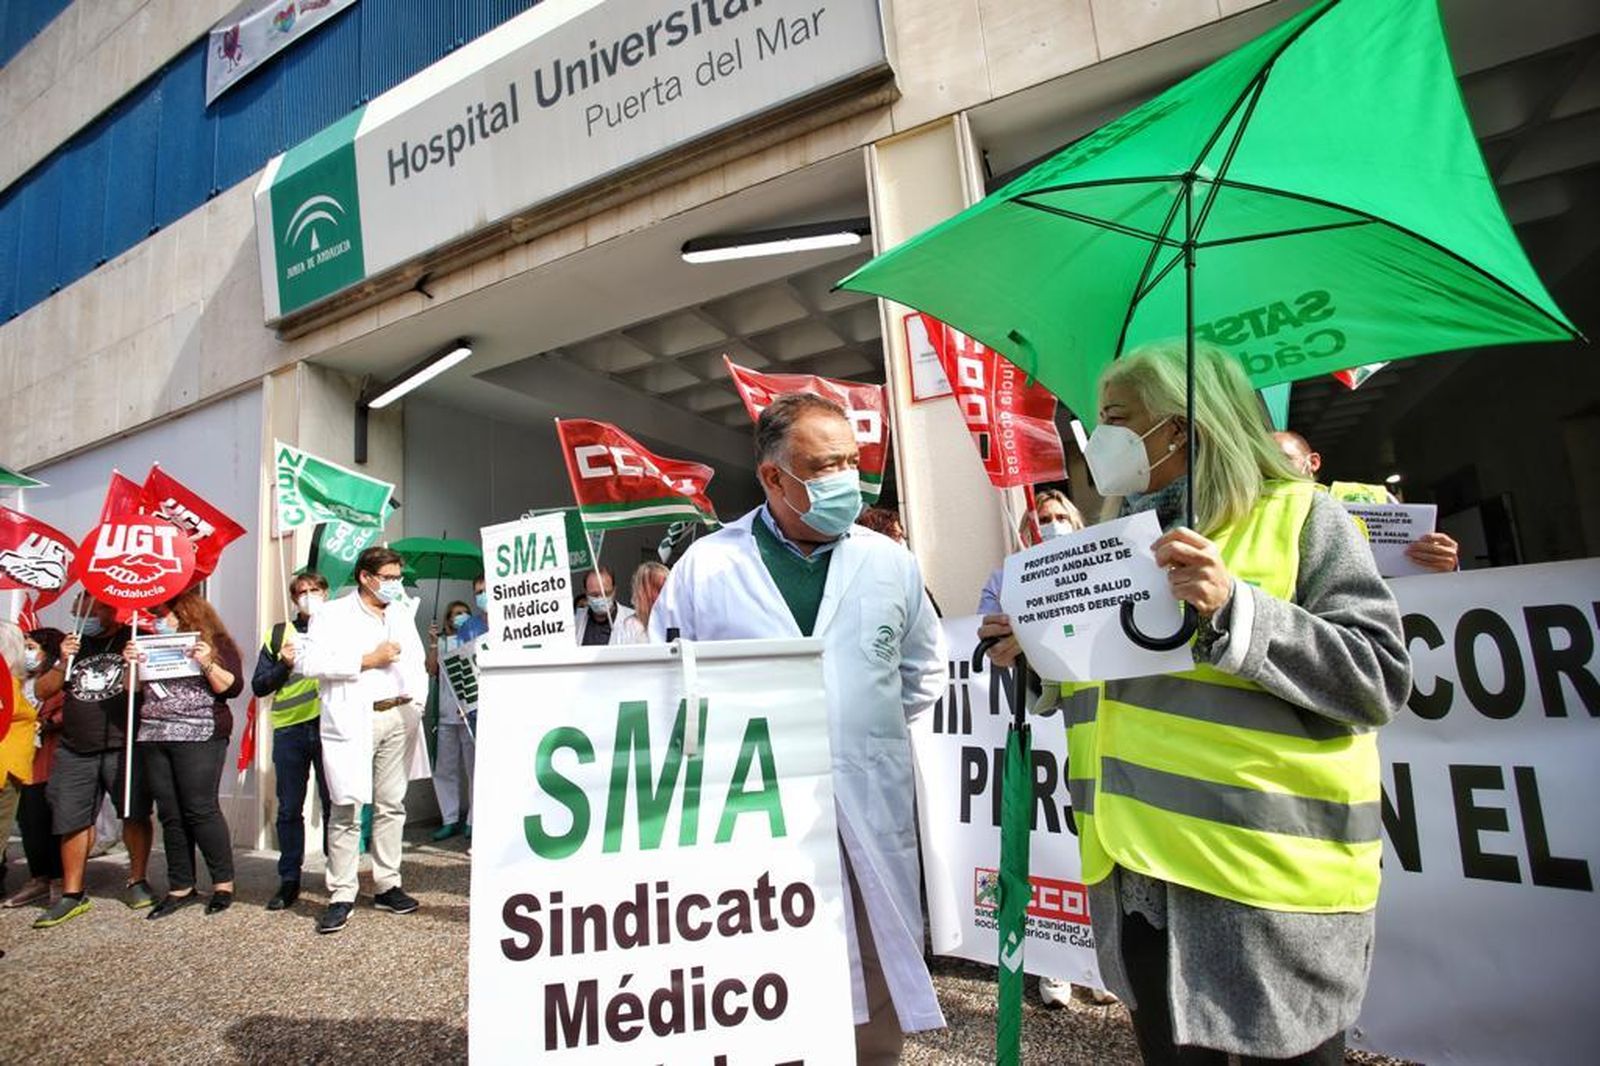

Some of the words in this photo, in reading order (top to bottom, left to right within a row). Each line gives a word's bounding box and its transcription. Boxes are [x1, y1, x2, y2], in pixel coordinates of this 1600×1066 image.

[585, 75, 682, 138] Puerta
[695, 38, 744, 88] del
[754, 8, 827, 61] Mar
[387, 83, 520, 186] Hospital
[306, 256, 316, 270] DE
[95, 524, 179, 560] UGT
[495, 533, 558, 577] SMA
[1024, 541, 1098, 571] PROFESIONALES
[1099, 537, 1123, 551] DEL
[1020, 565, 1060, 584] SERVICIO
[1062, 554, 1111, 574] ANDALUZ
[1115, 548, 1132, 560] DE
[1054, 572, 1088, 587] SALUD
[493, 577, 566, 601] Sindicato
[1026, 596, 1044, 608] POR
[1045, 586, 1091, 605] NUESTRA
[1093, 578, 1132, 593] SALUD
[503, 599, 560, 620] Médico
[1018, 613, 1035, 624] POR
[1037, 604, 1085, 621] NUESTROS
[1088, 590, 1150, 611] DERECHOS
[502, 620, 565, 642] Andaluz
[1401, 601, 1600, 720] COR
[523, 698, 787, 860] SMA
[1380, 762, 1422, 873] N
[1449, 764, 1593, 892] EL
[500, 871, 816, 962] Sindicato
[1038, 917, 1080, 935] sanidad
[1082, 928, 1090, 939] y
[1053, 931, 1068, 944] de
[544, 965, 789, 1052] Médico
